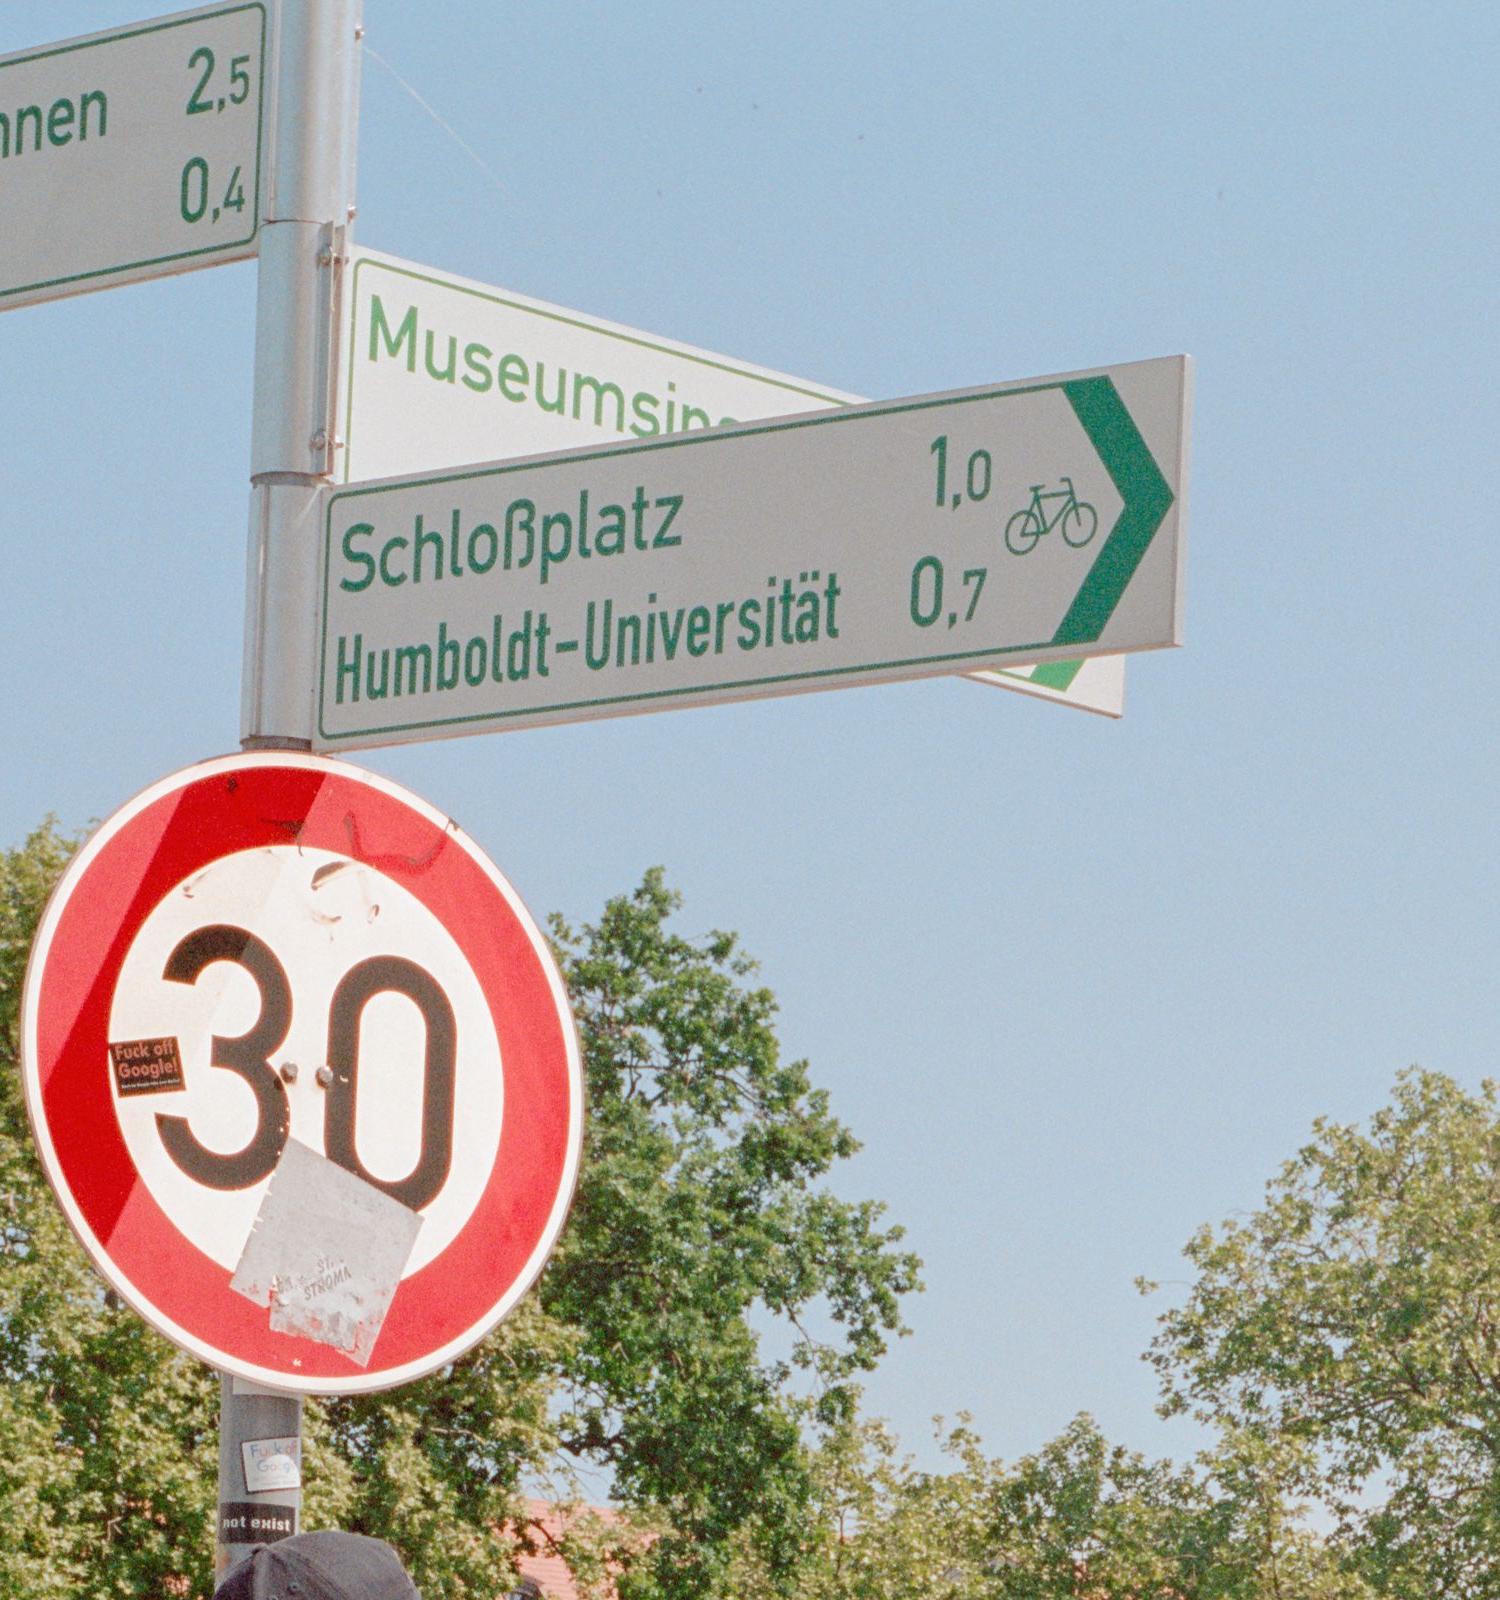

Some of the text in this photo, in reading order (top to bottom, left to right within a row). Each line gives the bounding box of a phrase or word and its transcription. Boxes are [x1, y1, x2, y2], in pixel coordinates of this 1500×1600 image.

[186, 47, 250, 116] 2,5
[179, 157, 245, 223] 0,4
[367, 295, 740, 438] Museumsin
[339, 436, 992, 593] Schloßplatz 1,0
[334, 556, 988, 706] Humboldt-Universität 0,7
[115, 1040, 173, 1060] Fuck off
[119, 1056, 178, 1079] Google!
[155, 924, 457, 1212] 30
[222, 1516, 291, 1532] not exist
